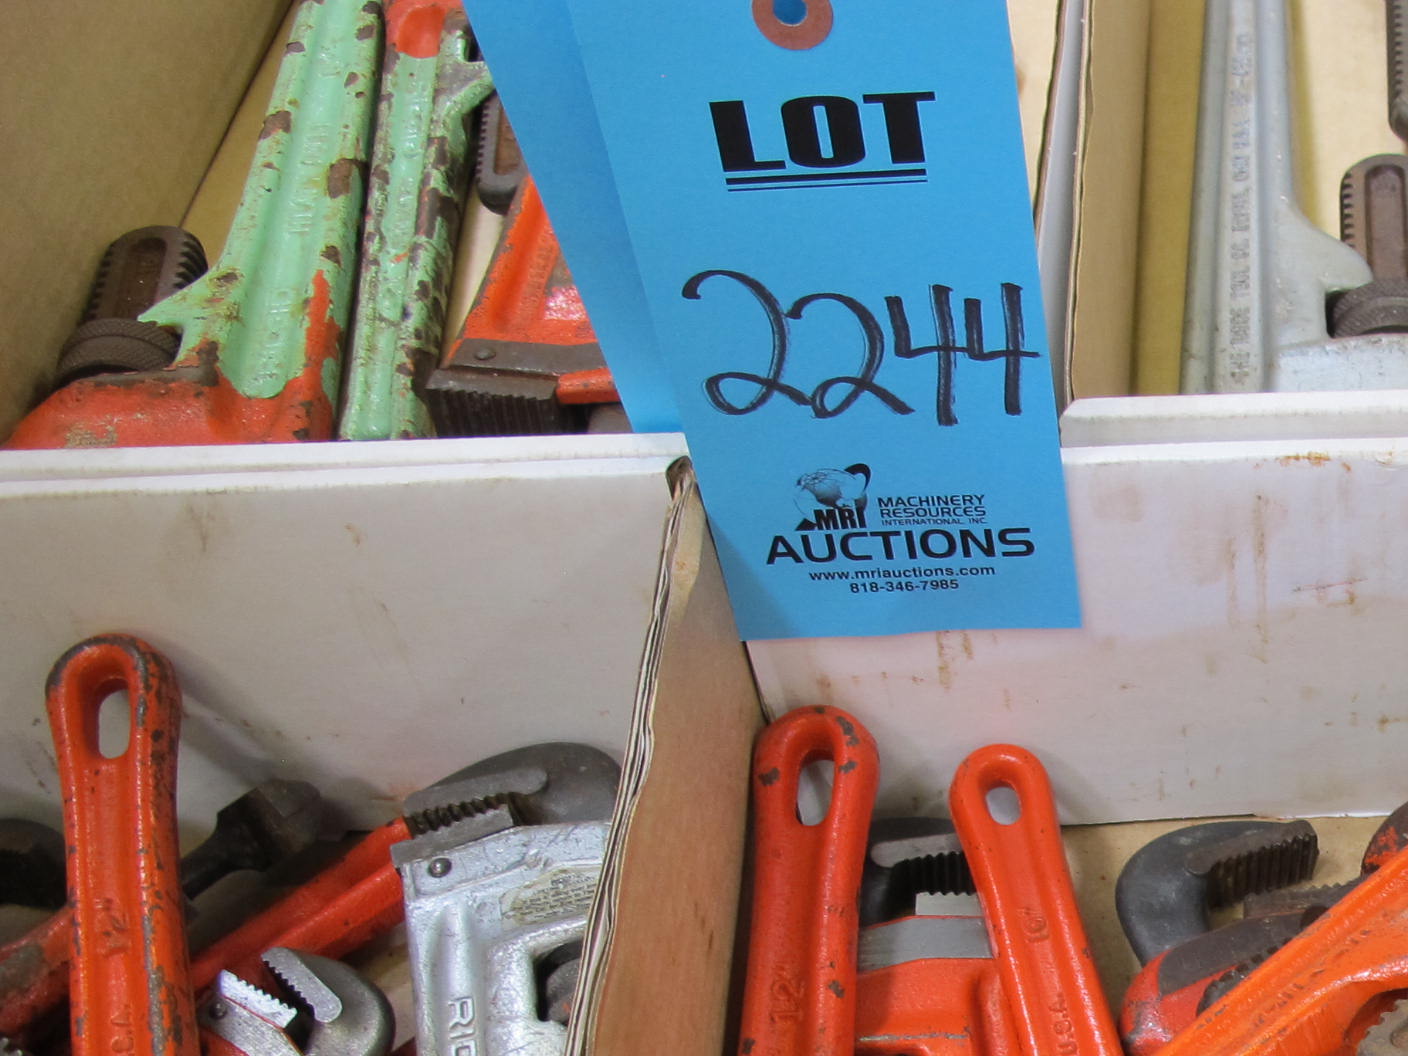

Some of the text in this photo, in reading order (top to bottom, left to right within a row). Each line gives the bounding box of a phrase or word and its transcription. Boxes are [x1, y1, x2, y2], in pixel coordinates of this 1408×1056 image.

[709, 91, 936, 172] LOT
[682, 270, 1040, 426] 2244
[878, 494, 985, 508] MACHINERY
[880, 506, 987, 518] RESOURCES
[766, 527, 1036, 565] AUCTIONS
[809, 565, 996, 581] www.mriauctions.com
[850, 579, 959, 593] 818-346-7985
